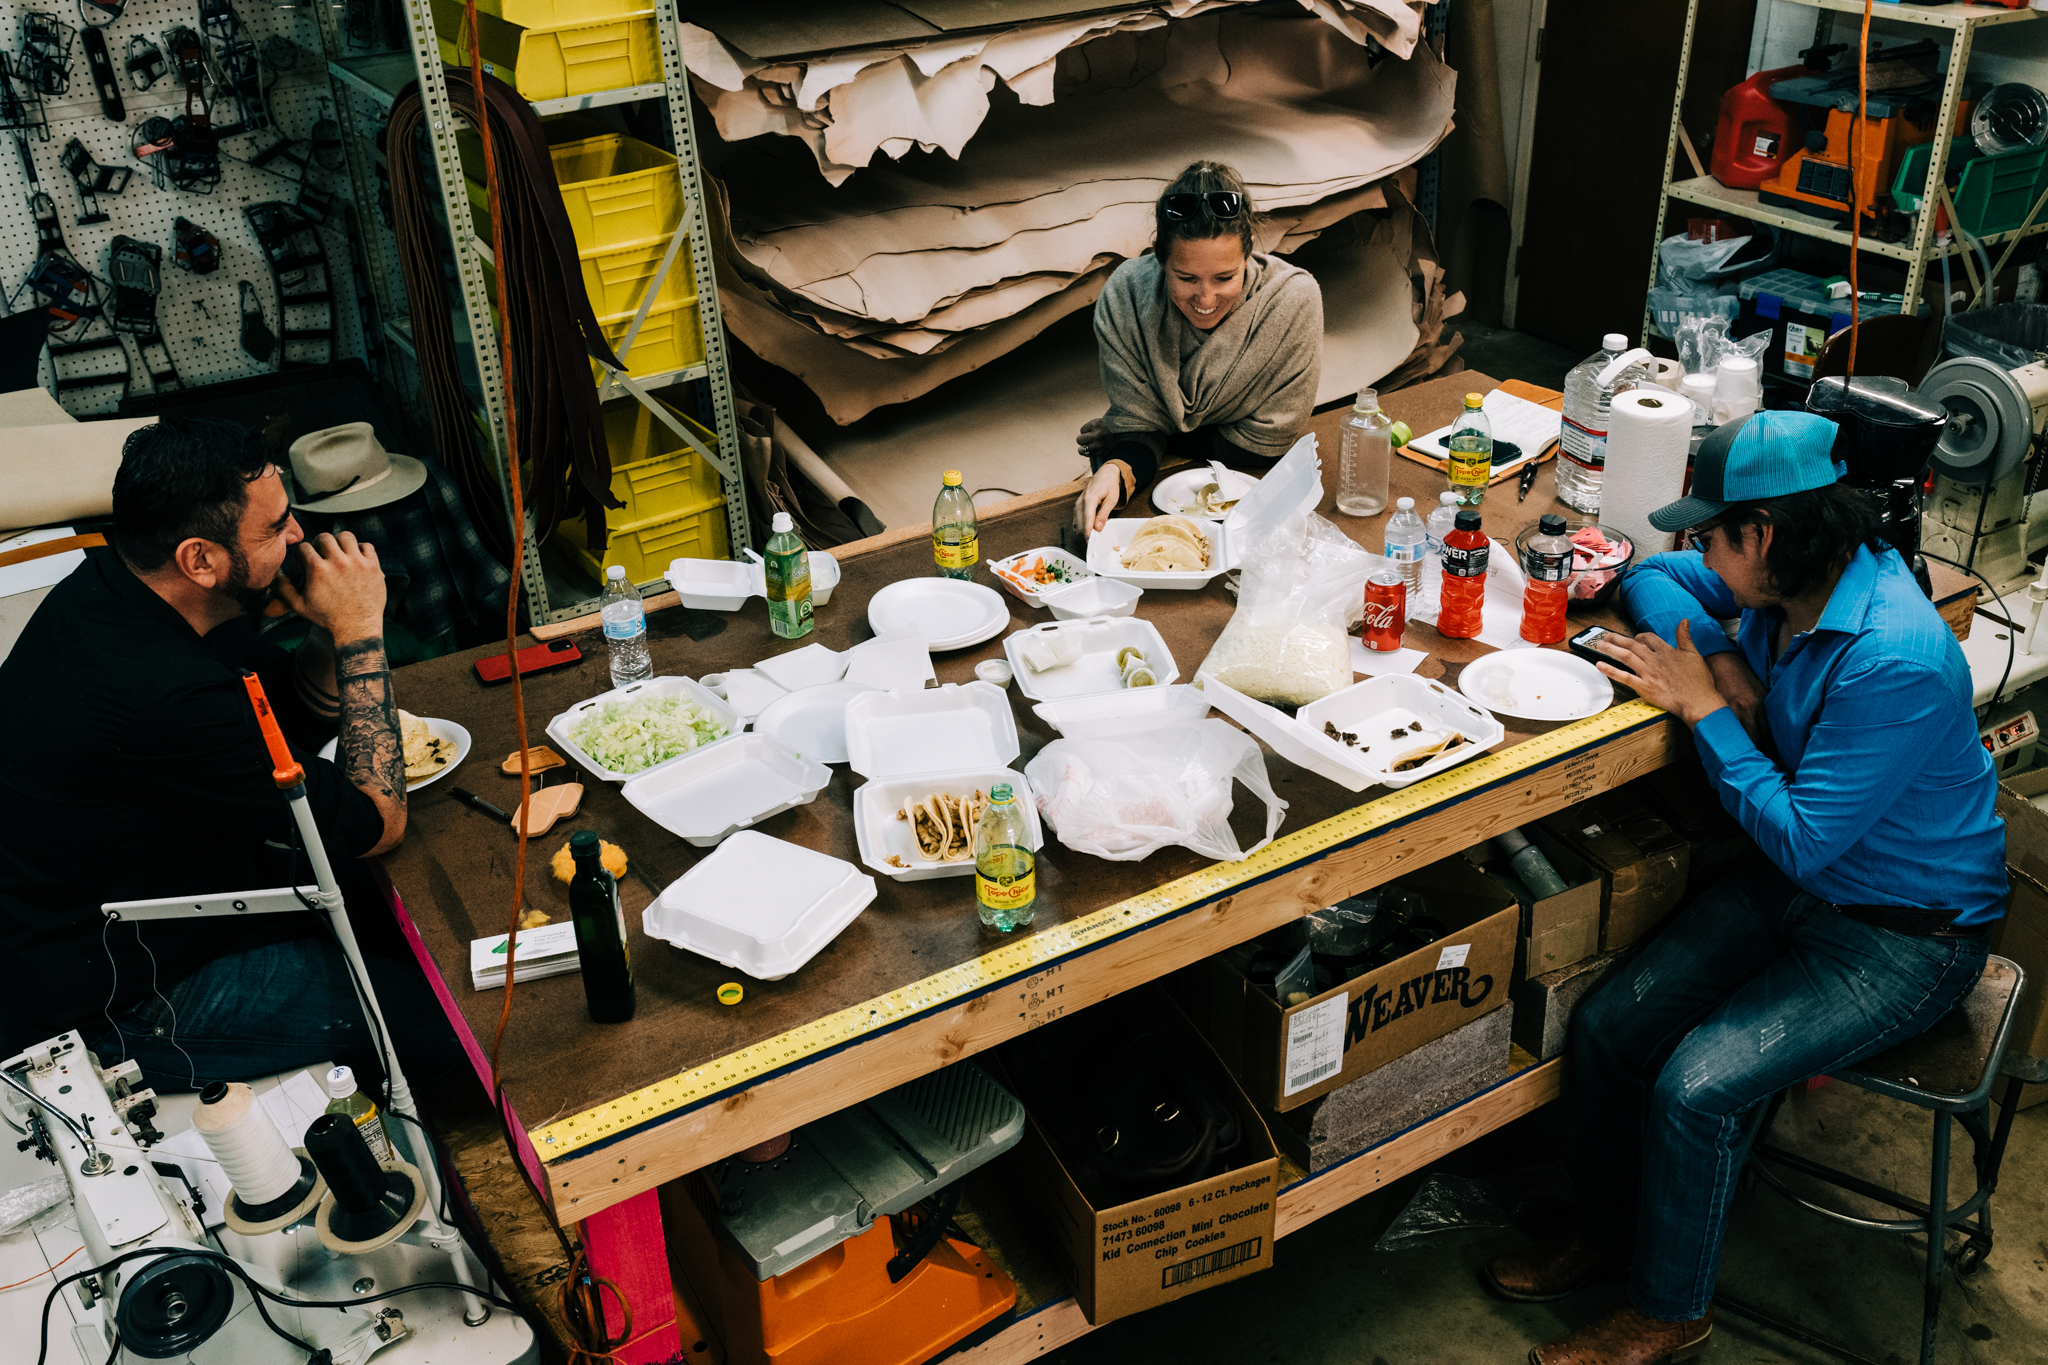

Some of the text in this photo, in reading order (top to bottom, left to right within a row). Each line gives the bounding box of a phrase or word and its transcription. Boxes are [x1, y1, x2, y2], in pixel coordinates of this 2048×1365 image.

[1454, 466, 1472, 475] Topo
[1566, 763, 1594, 779] PREMIUM
[1564, 784, 1592, 800] PREMIUM
[984, 884, 1031, 898] Topo Chico
[1074, 916, 1116, 936] SWANSON
[1046, 984, 1064, 998] HT
[1047, 1006, 1064, 1019] HT
[1344, 967, 1494, 1054] WEAVER
[1102, 1219, 1128, 1233] Stock
[1131, 1214, 1146, 1224] No.
[1154, 1203, 1181, 1217] 60098
[1189, 1198, 1194, 1207] 6
[1202, 1193, 1212, 1203] 12
[1215, 1189, 1227, 1199] Ct.
[1230, 1175, 1271, 1195] Packages
[1102, 1202, 1269, 1261] Kid Connection Mini Chocolate
[1102, 1221, 1165, 1246] 71473 60098
[1155, 1229, 1226, 1259] Chip Cookies
